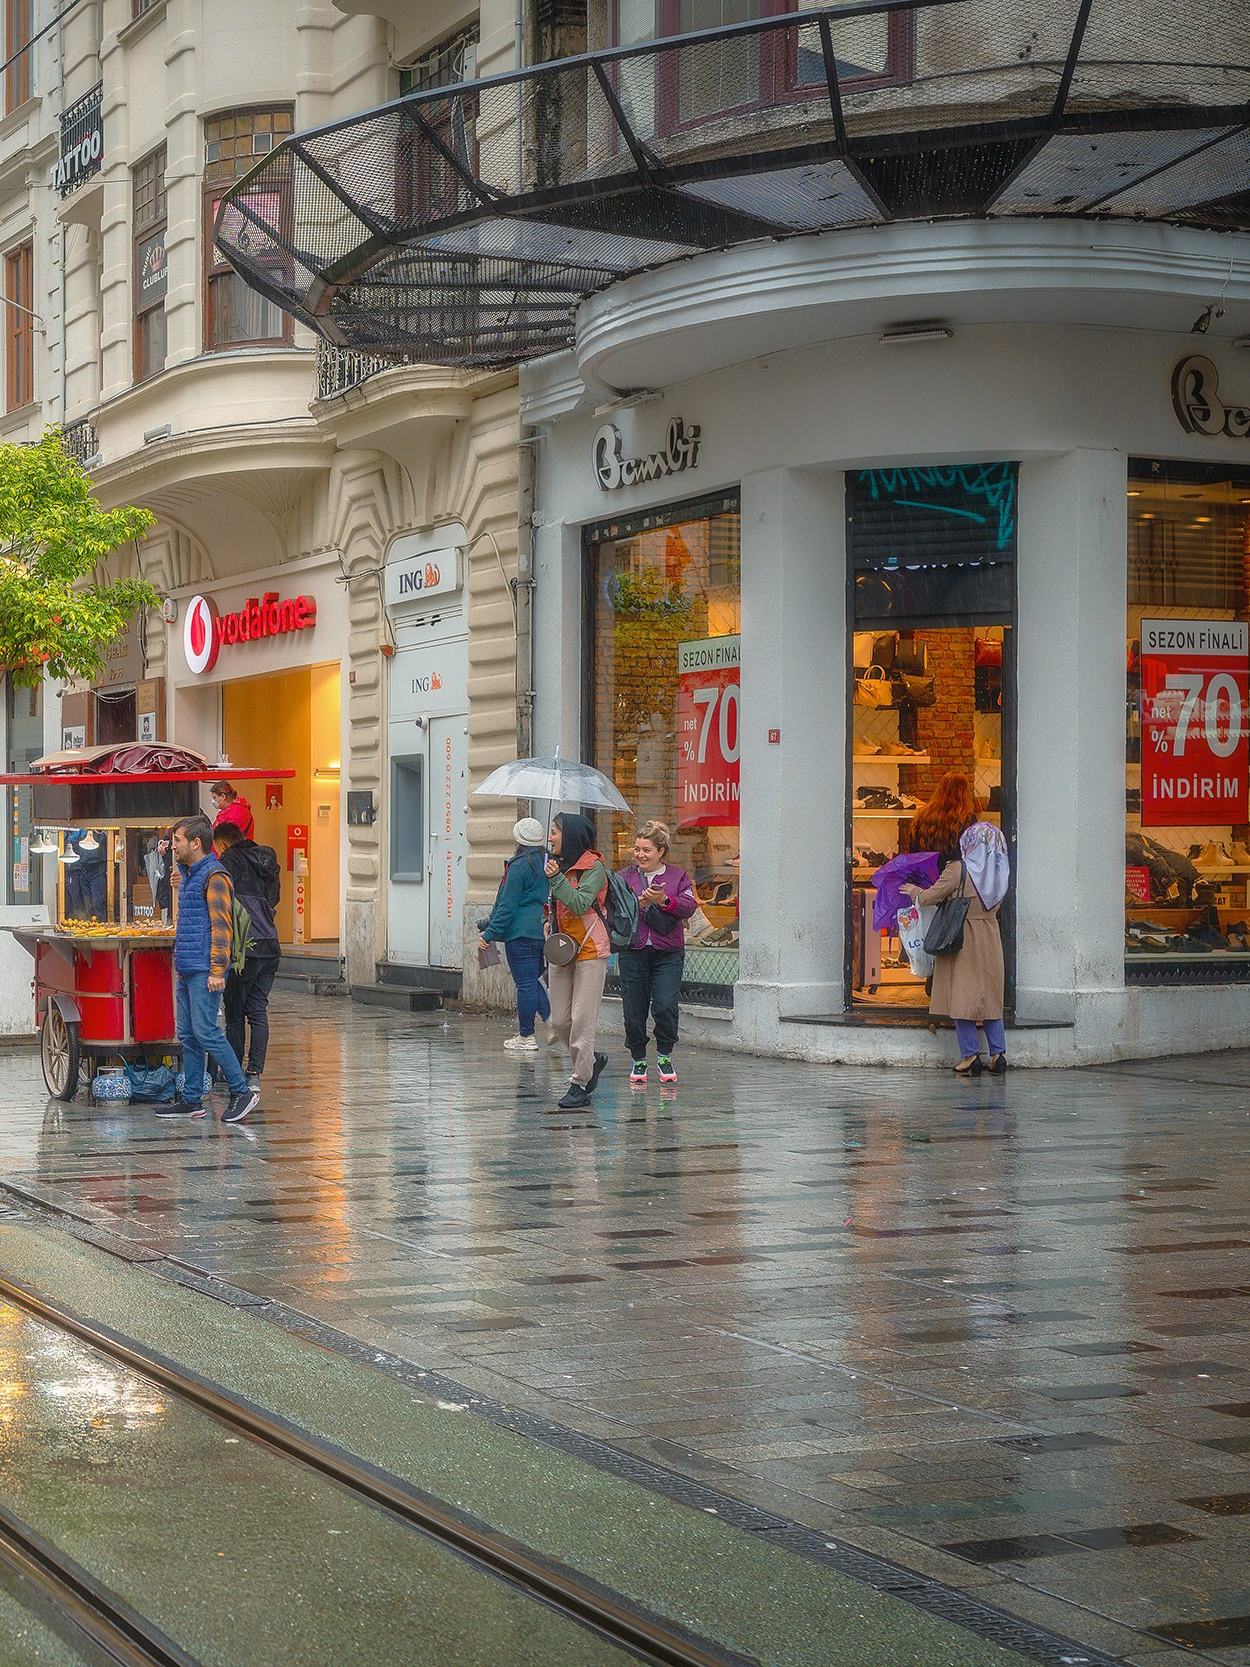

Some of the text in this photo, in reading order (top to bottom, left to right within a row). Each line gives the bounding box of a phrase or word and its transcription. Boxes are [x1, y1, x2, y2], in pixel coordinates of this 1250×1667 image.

[50, 130, 101, 192] TATTOO
[591, 416, 701, 491] Bambi
[399, 570, 423, 594] ING
[216, 591, 316, 645] vodafone
[1148, 628, 1243, 650] SEZON FİNALİ
[683, 649, 713, 668] SEZON
[411, 677, 429, 693] ING
[1151, 705, 1171, 719] net
[1165, 673, 1242, 758] 70
[684, 717, 697, 730] net
[445, 764, 452, 772] 0
[1152, 773, 1239, 799] İNDİRİM
[134, 905, 154, 917] TATTOO
